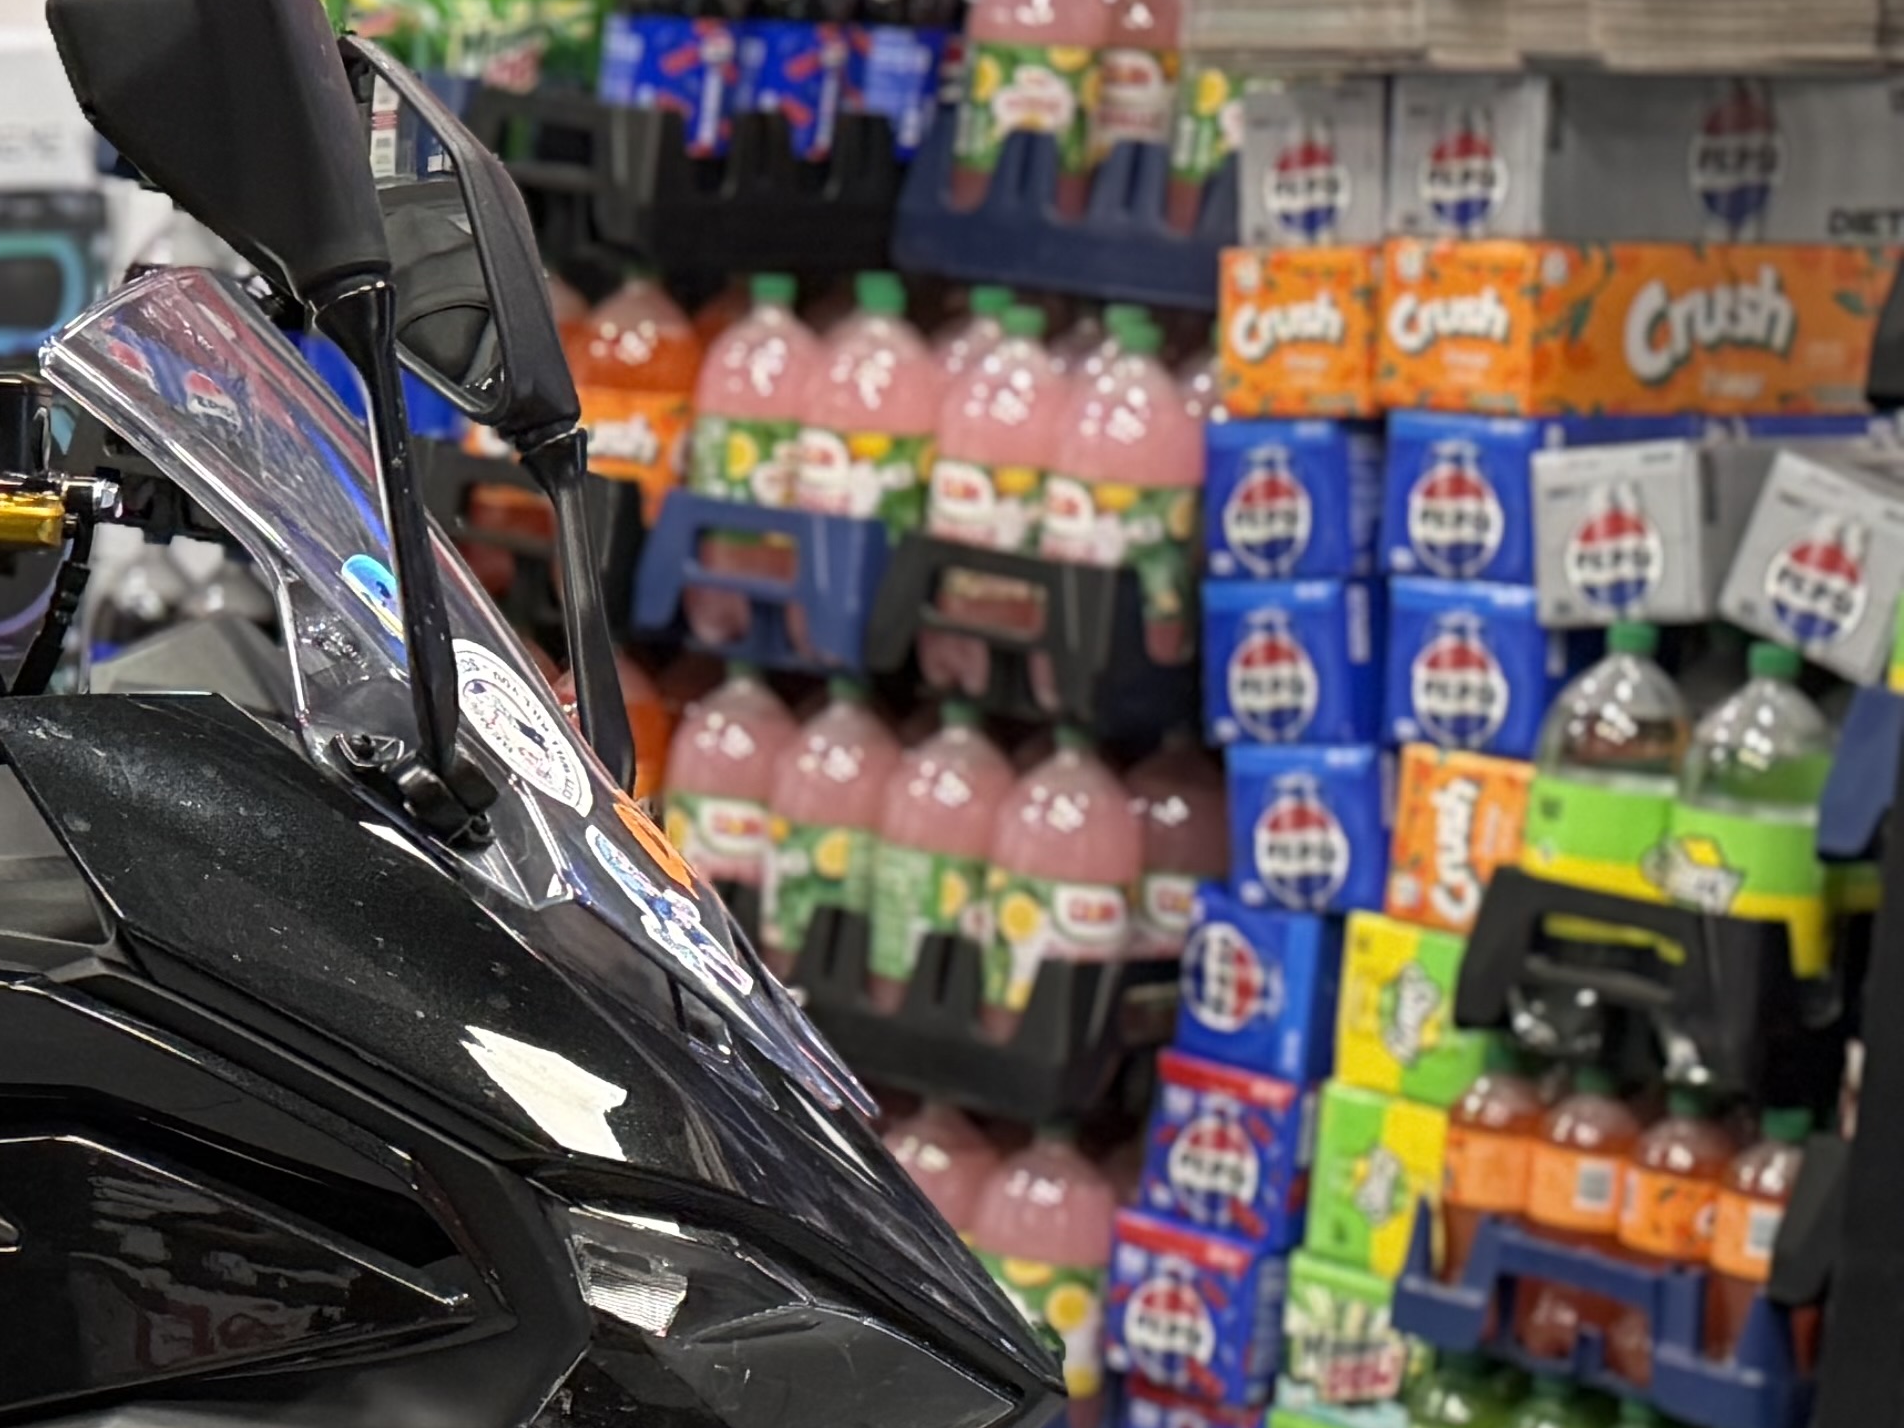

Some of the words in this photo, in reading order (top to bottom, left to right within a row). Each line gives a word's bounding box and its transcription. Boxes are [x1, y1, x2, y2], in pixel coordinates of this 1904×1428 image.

[1230, 290, 1346, 362] Crush
[1387, 283, 1512, 355] Crush
[1622, 262, 1797, 384] Crush
[1428, 777, 1481, 922] Crush
